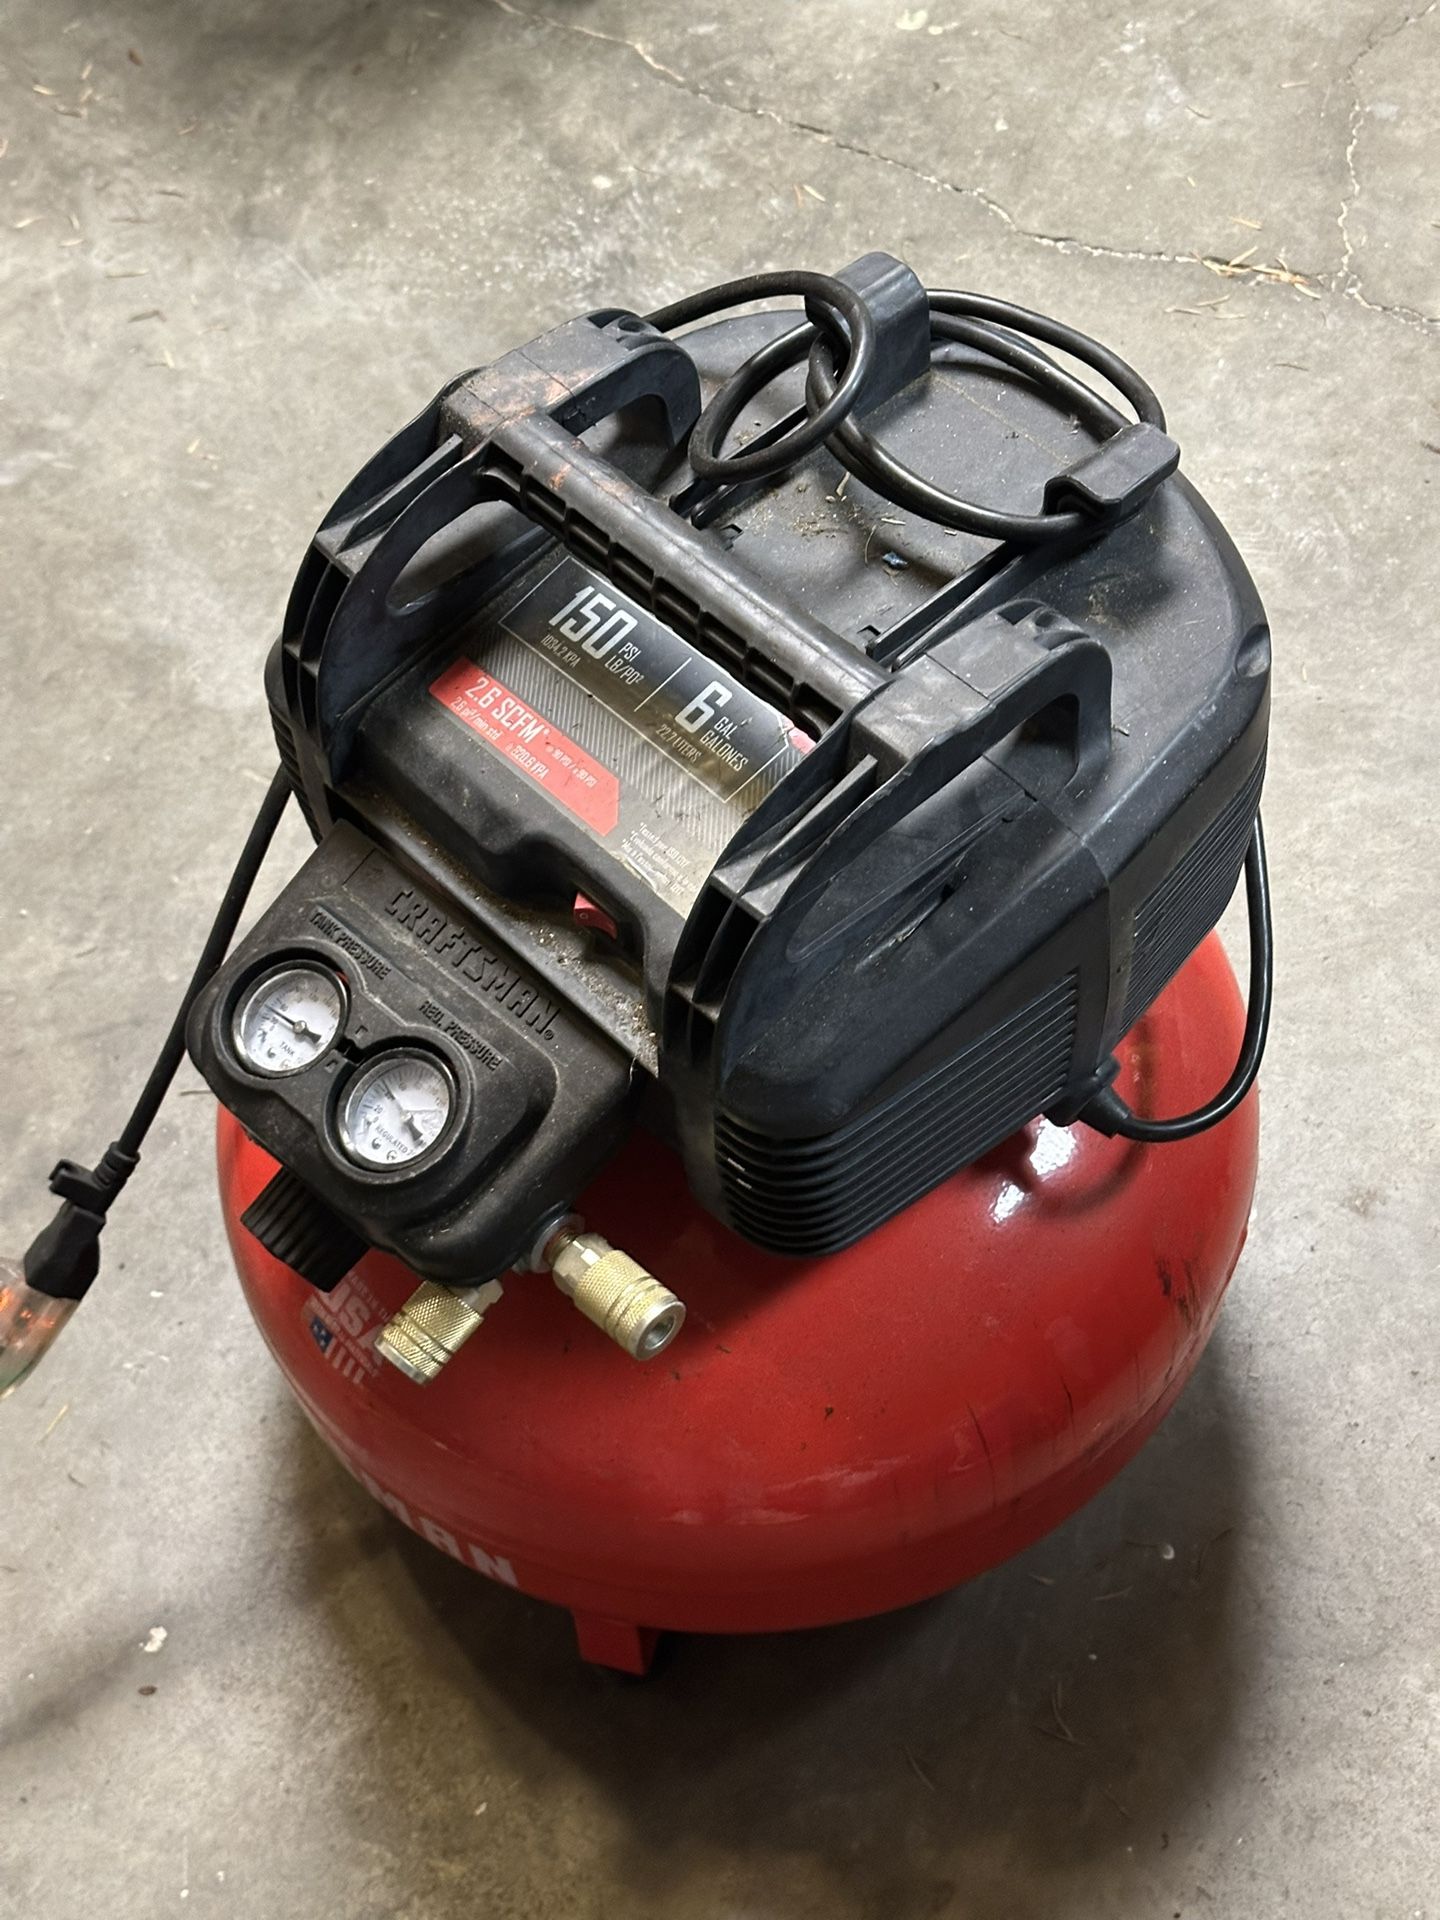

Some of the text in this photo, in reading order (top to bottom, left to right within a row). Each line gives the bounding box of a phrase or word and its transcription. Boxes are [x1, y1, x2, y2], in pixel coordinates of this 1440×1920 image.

[548, 585, 638, 659] 150
[562, 651, 581, 668] KPA
[618, 642, 642, 662] PSI
[465, 677, 502, 709] 2.6
[675, 681, 733, 733] 6
[451, 697, 467, 712] 2.6
[486, 722, 504, 740] std
[714, 716, 738, 740] GAL
[672, 737, 702, 763] LITERS
[700, 730, 749, 772] GALONES
[309, 911, 392, 980] TANK PRESSURE
[280, 1041, 295, 1056] TANK
[445, 1018, 503, 1071] PRESSURE
[375, 1126, 408, 1153] REGULATED
